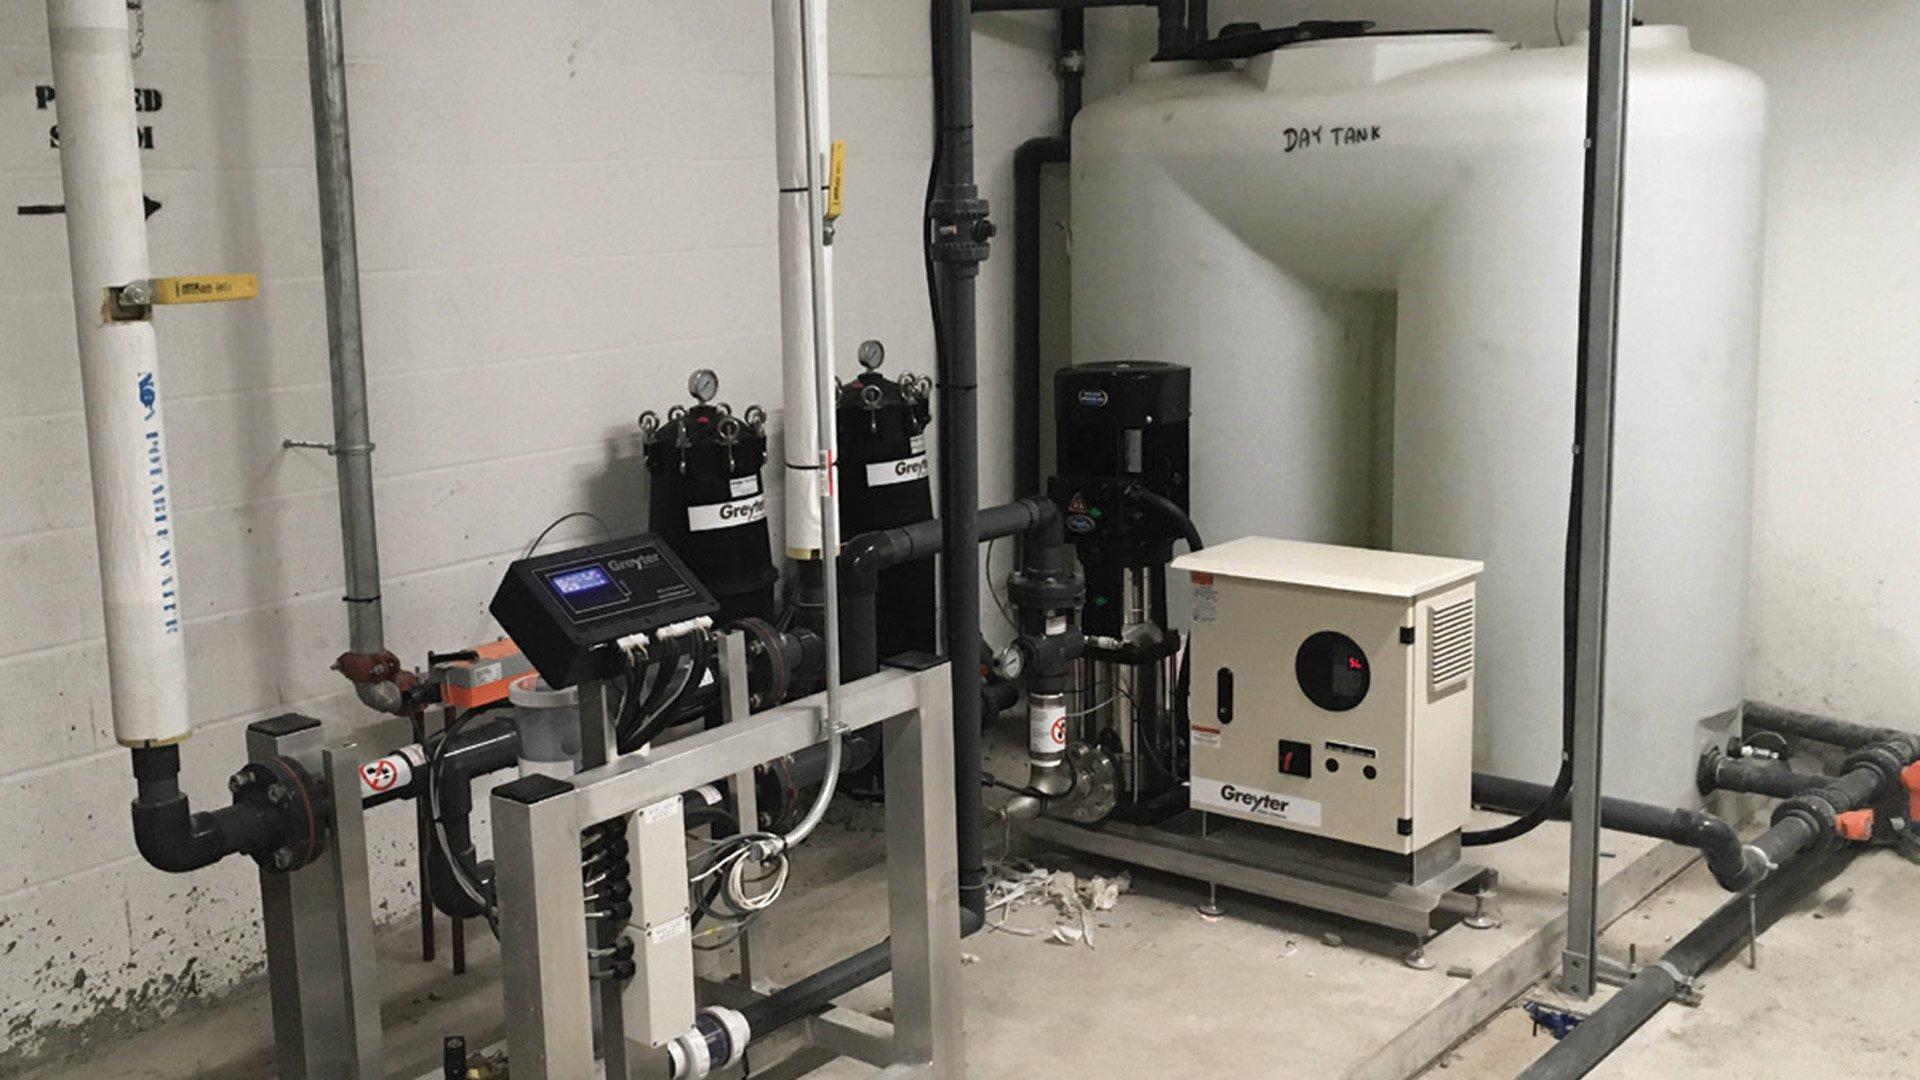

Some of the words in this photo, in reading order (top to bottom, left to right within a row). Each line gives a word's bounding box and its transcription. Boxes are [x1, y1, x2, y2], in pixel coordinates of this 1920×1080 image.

[1283, 126, 1322, 153] DAY
[1330, 126, 1381, 147] TANK
[608, 553, 660, 571] Greyter
[1221, 785, 1290, 812] Greyter
